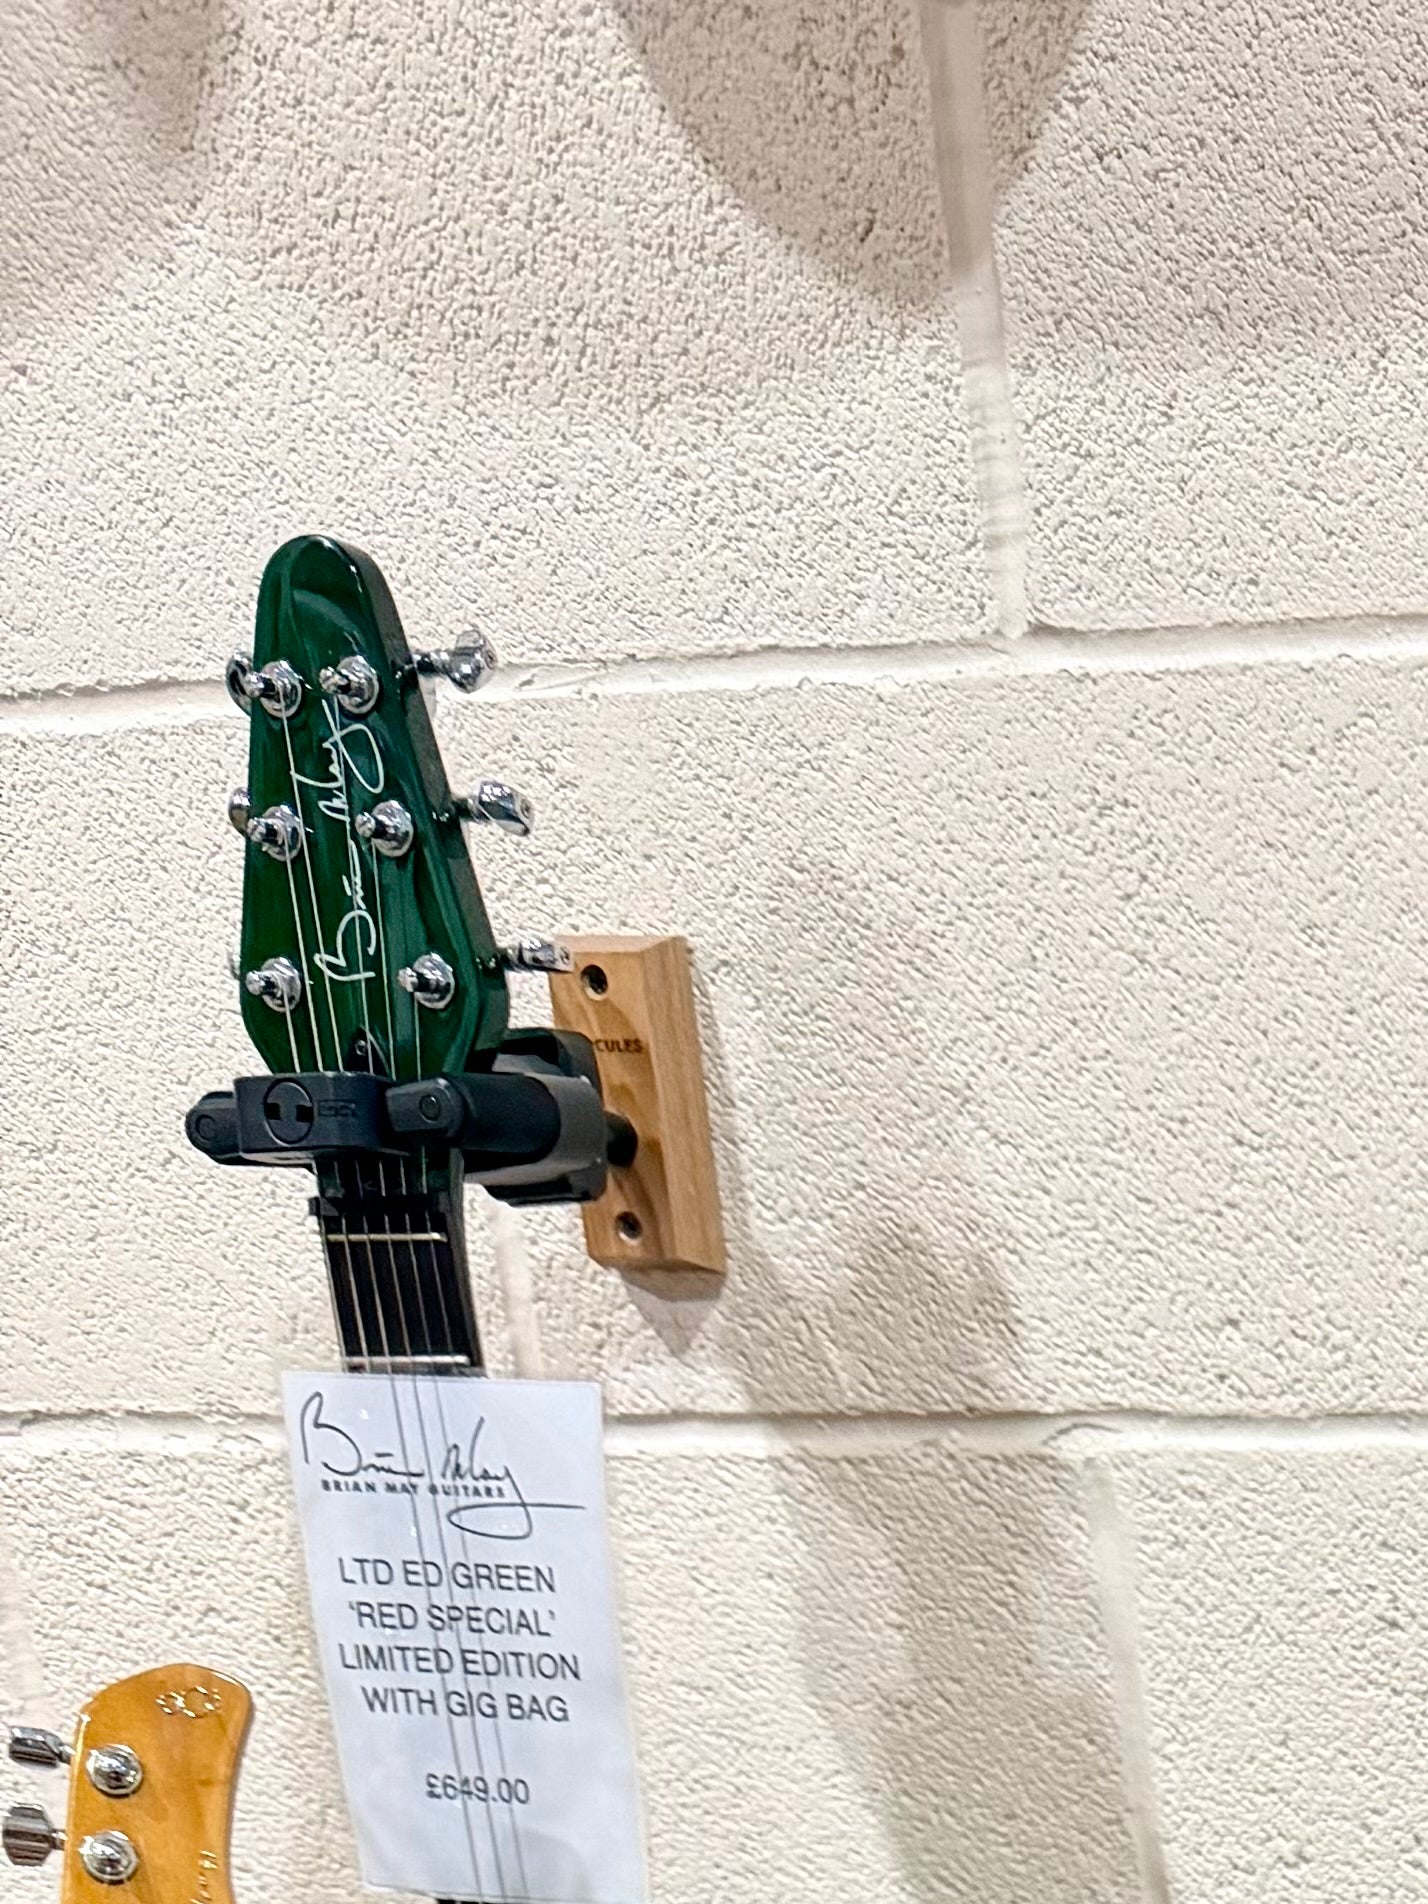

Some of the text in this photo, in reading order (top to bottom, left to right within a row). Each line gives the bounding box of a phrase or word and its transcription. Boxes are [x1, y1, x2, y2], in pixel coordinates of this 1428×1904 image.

[593, 1038, 643, 1054] CULES
[321, 1479, 505, 1497] BRIAN MAY GUITARS
[338, 1557, 556, 1593] LTD ED GREEN
[339, 1643, 581, 1681] LIMITED EDITION
[362, 1688, 570, 1723] WITH GIG BAG
[425, 1774, 530, 1804] £649.00
